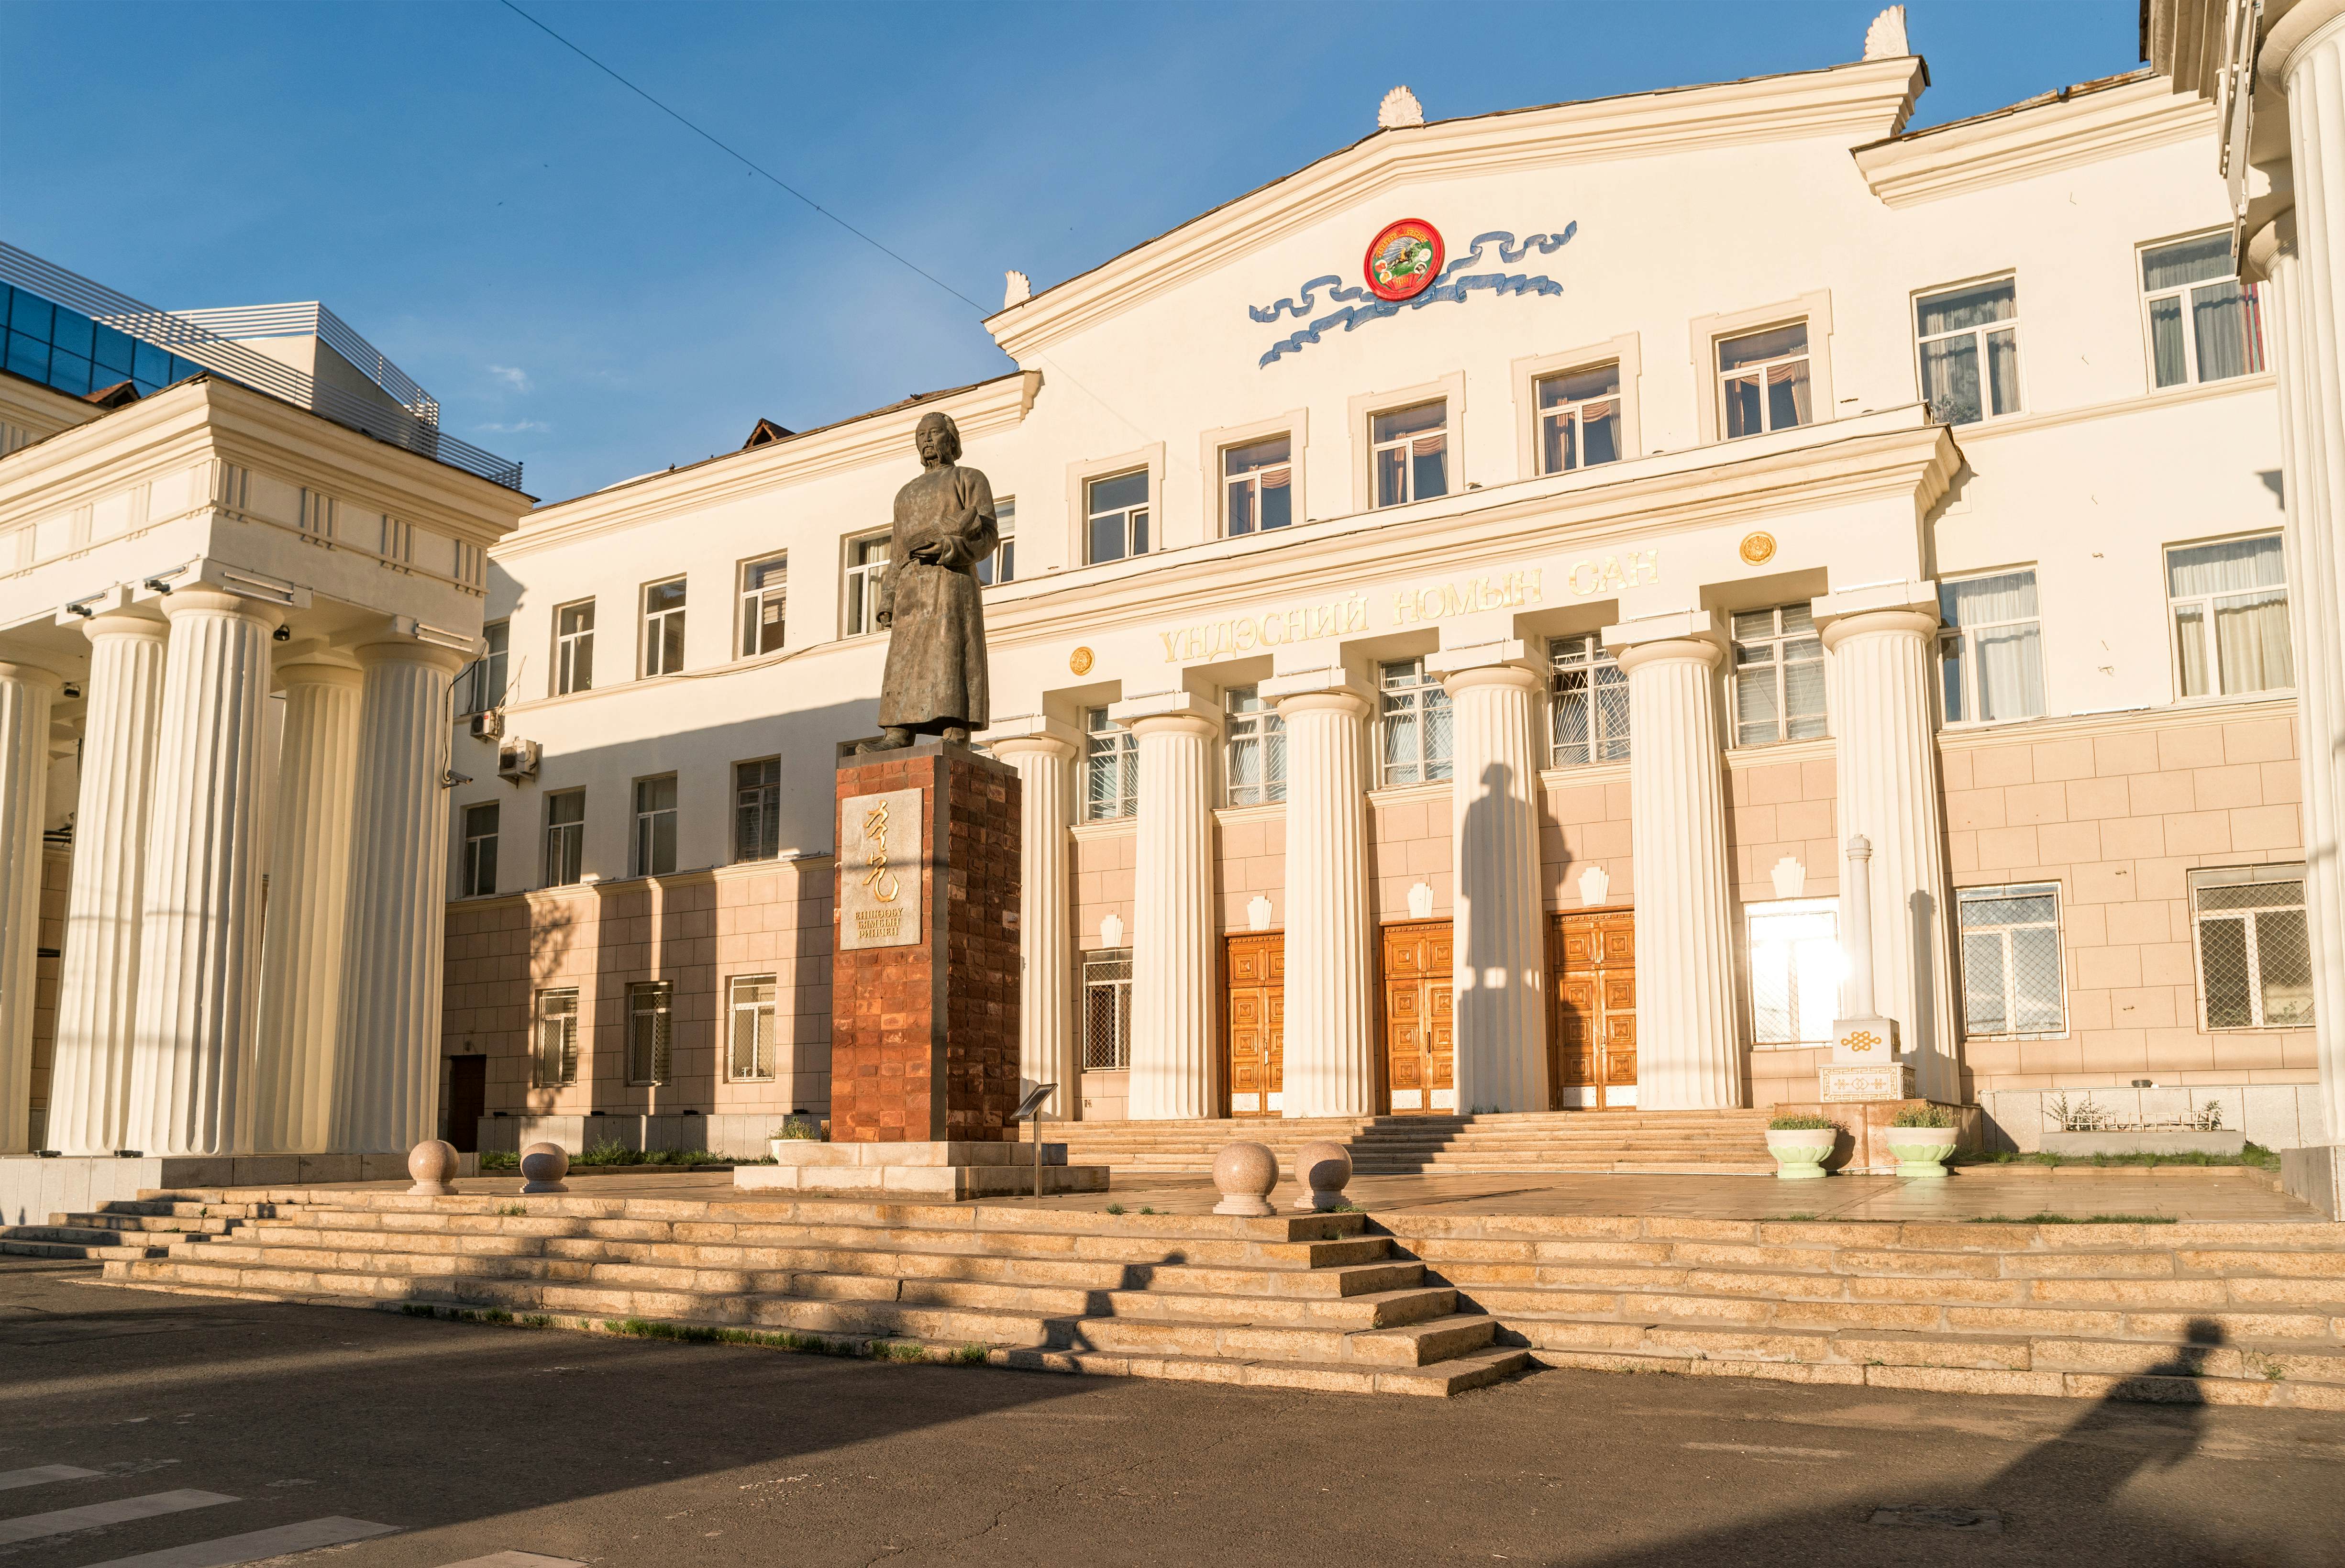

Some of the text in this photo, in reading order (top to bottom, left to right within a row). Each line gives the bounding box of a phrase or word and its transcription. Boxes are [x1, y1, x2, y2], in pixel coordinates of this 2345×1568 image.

[1159, 549, 1659, 663] ҮНДЭСНИЙ НОМЫН САН
[857, 917, 900, 929] БЯМБЫН
[858, 928, 898, 939] РИНЧЕН
